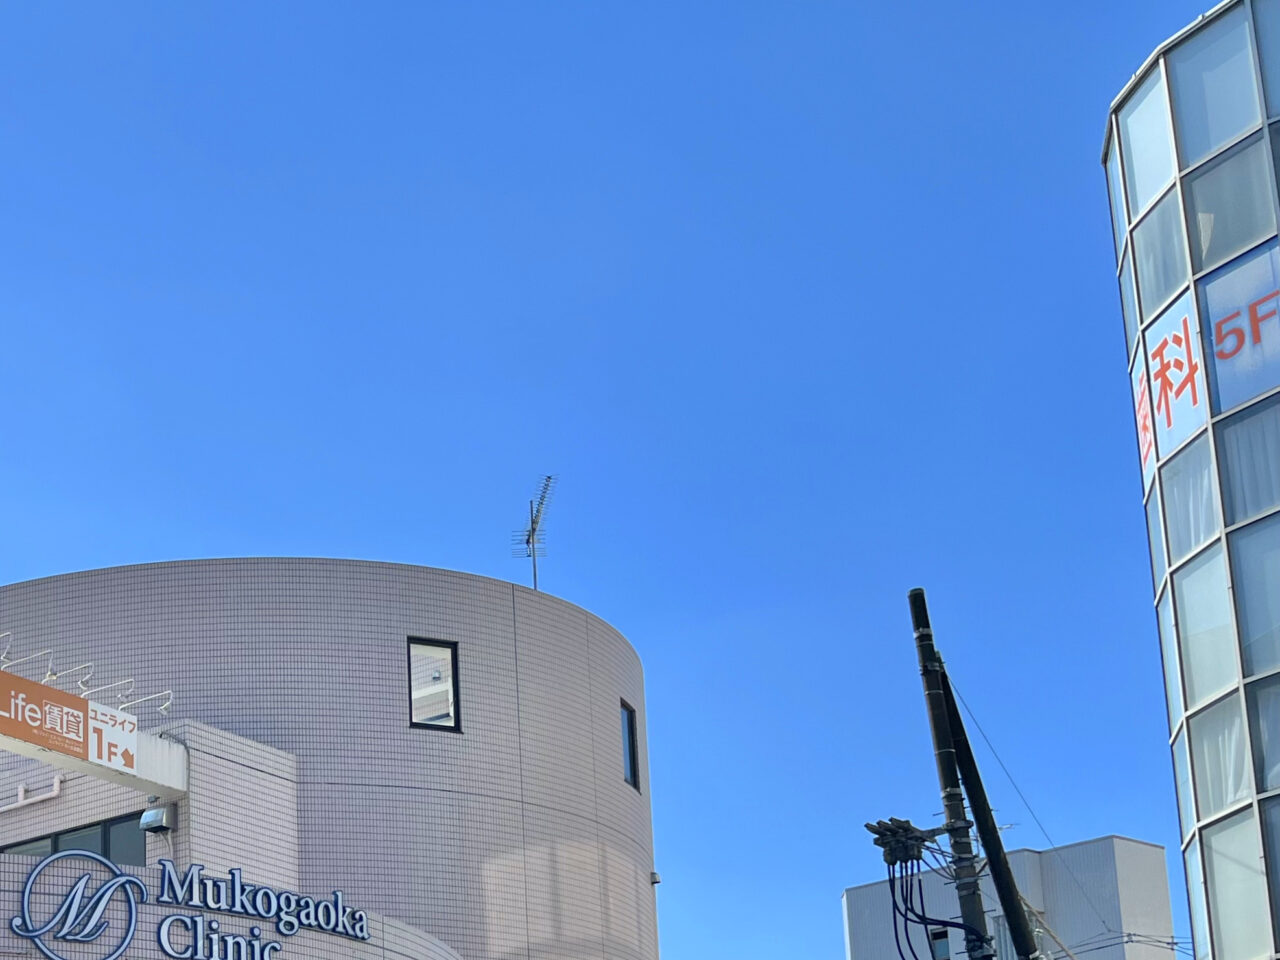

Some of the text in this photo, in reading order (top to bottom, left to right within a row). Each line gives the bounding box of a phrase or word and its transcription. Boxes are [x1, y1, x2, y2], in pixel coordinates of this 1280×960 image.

[88, 708, 137, 734] ユニライフ
[92, 726, 118, 763] 1F
[157, 858, 370, 941] Mukogaoka
